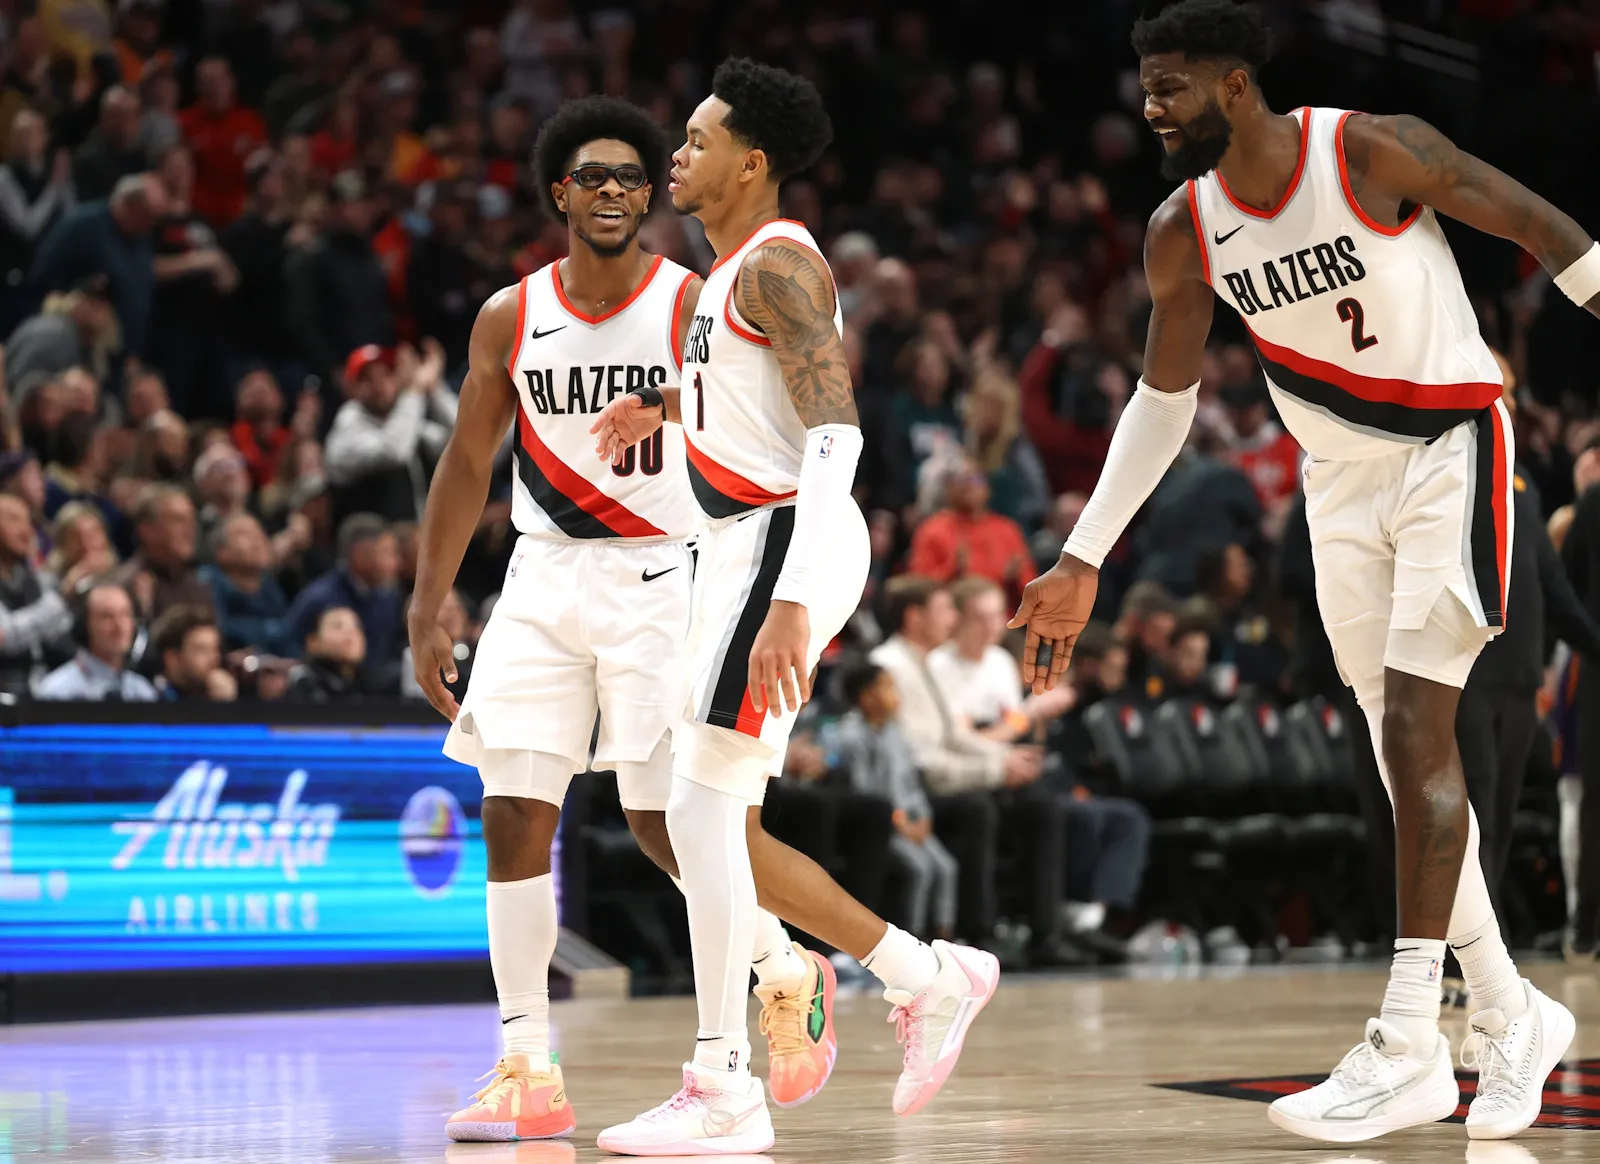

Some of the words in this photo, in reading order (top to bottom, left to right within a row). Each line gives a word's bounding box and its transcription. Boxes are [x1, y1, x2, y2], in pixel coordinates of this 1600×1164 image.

[1222, 235, 1366, 316] BLAZERS
[1336, 297, 1379, 353] 2
[693, 371, 704, 431] 1
[112, 760, 341, 882] Alaska
[126, 892, 318, 933] AIRLINES
